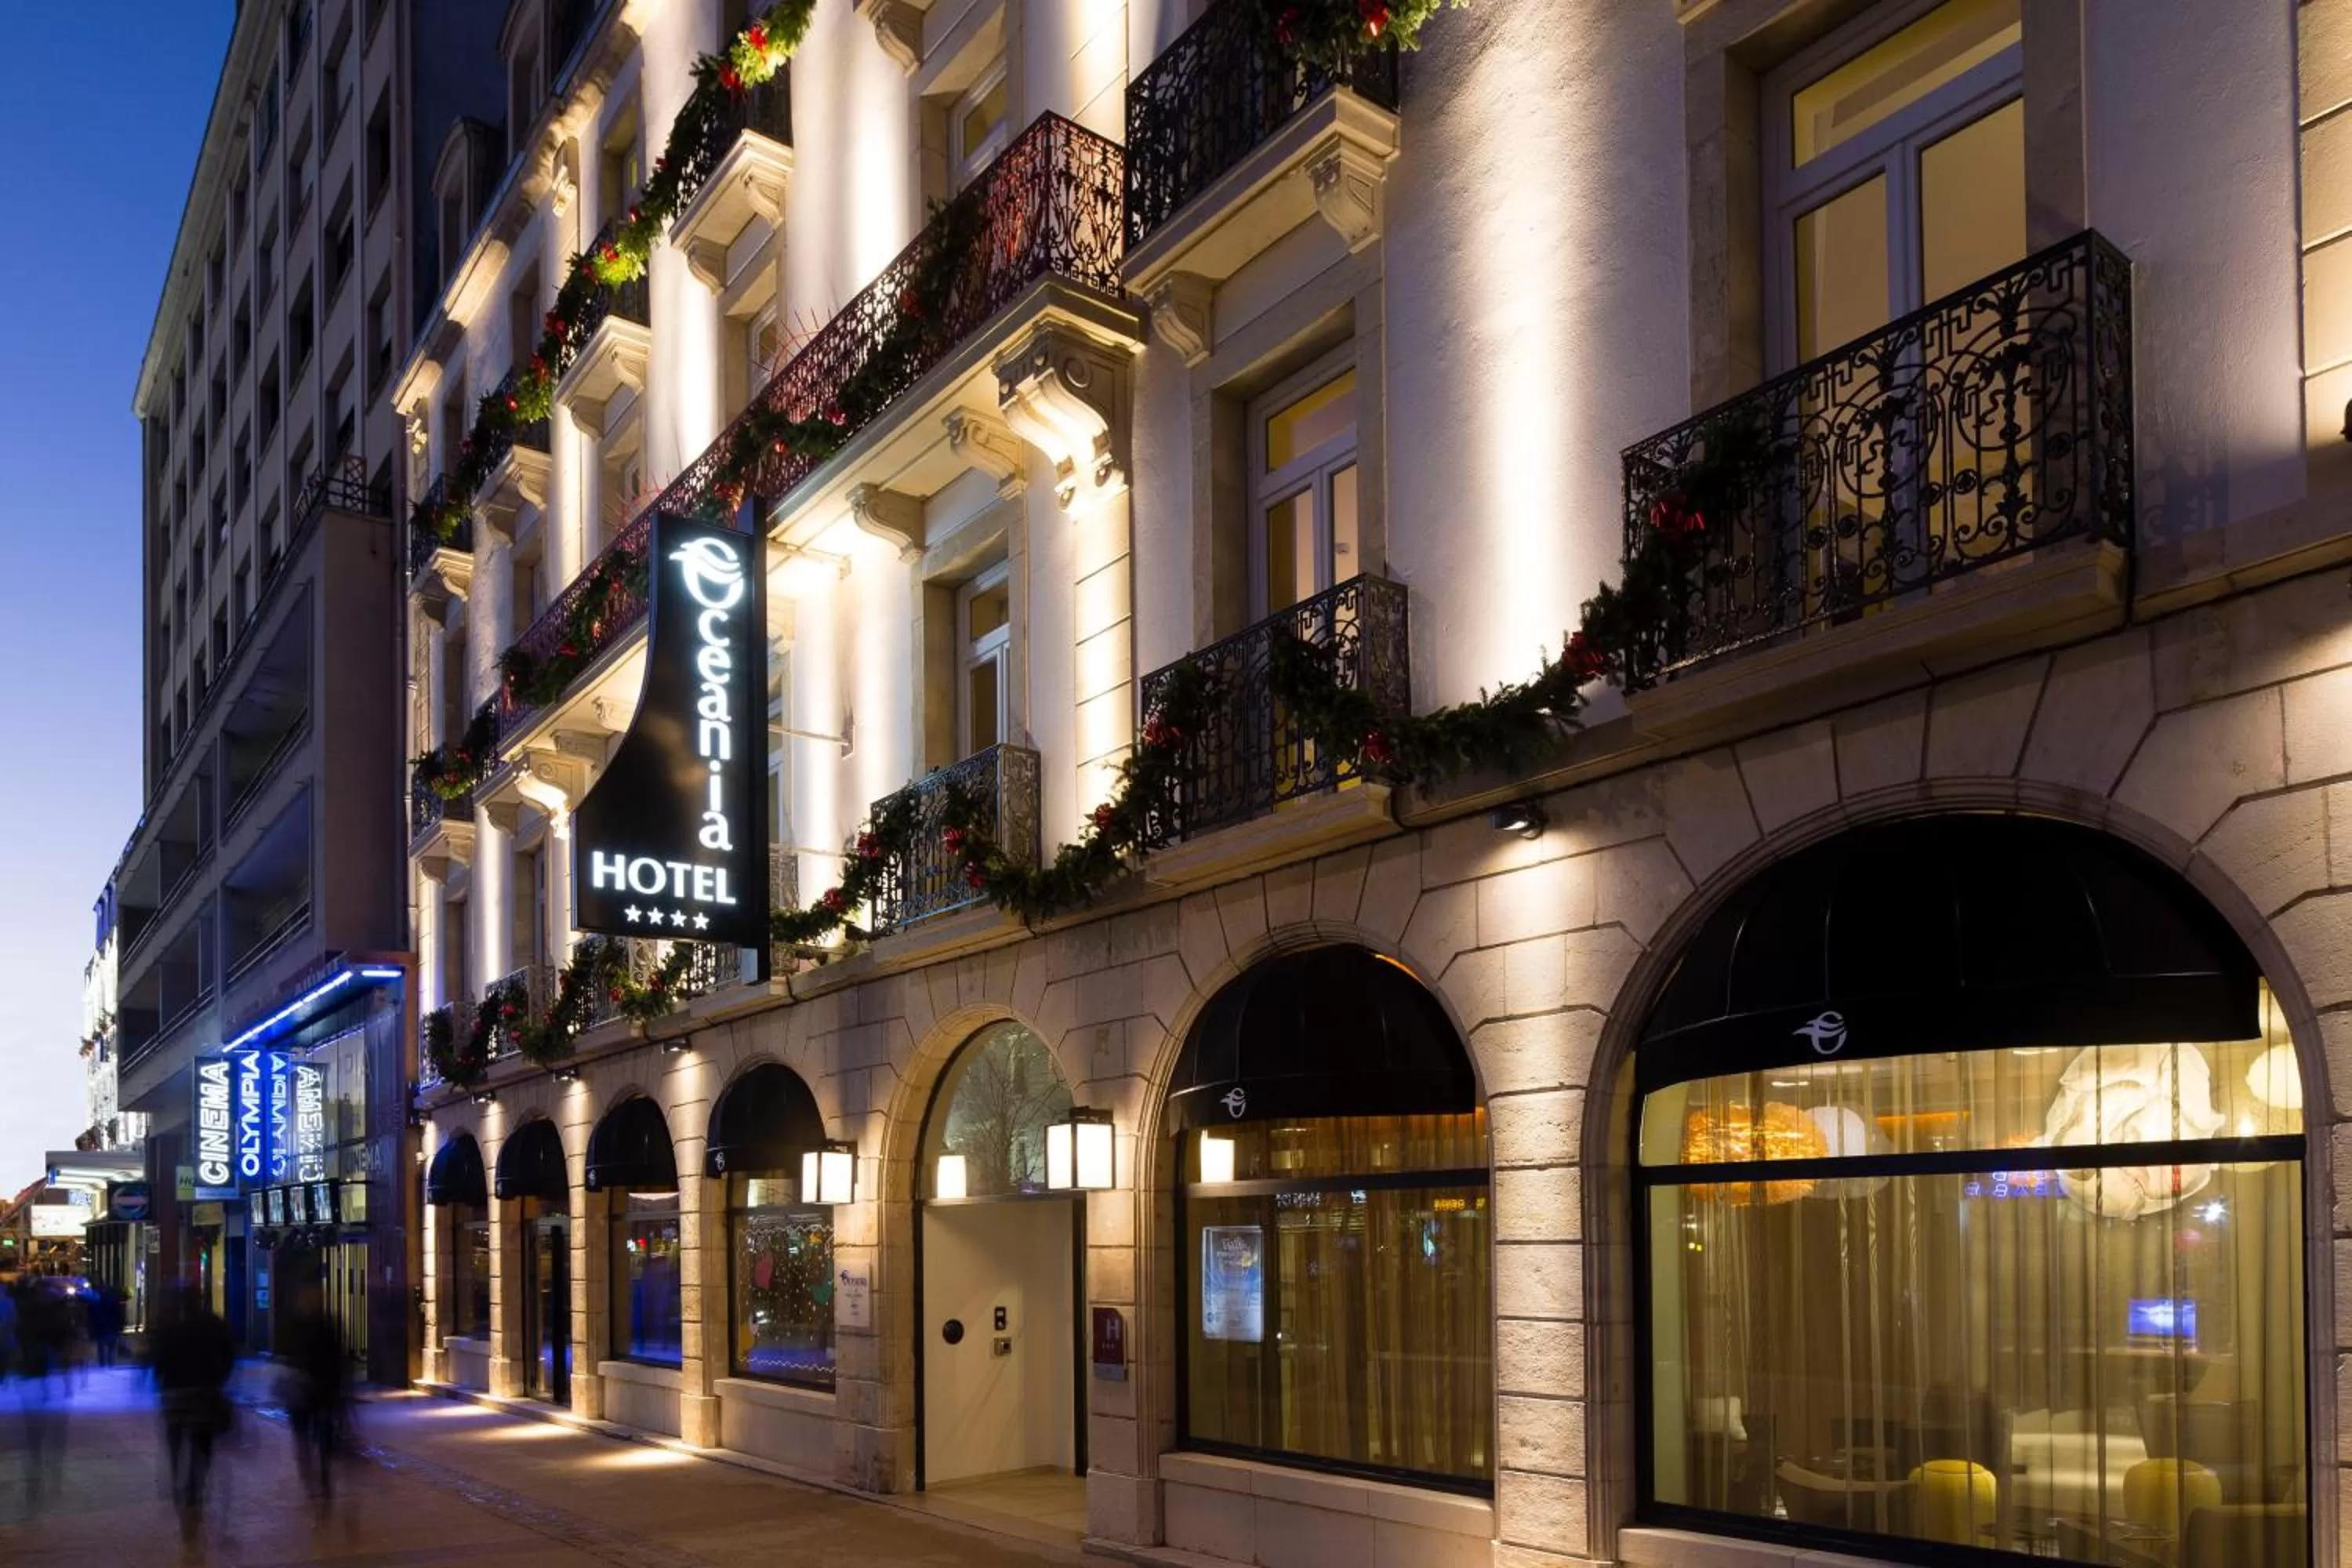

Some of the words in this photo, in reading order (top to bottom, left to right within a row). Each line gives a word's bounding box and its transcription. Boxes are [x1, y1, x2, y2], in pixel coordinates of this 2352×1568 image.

[669, 536, 746, 851] Oceania
[591, 850, 737, 906] HOTEL
[199, 1061, 230, 1185] CINEMA
[241, 1051, 260, 1176] OLYMPIA
